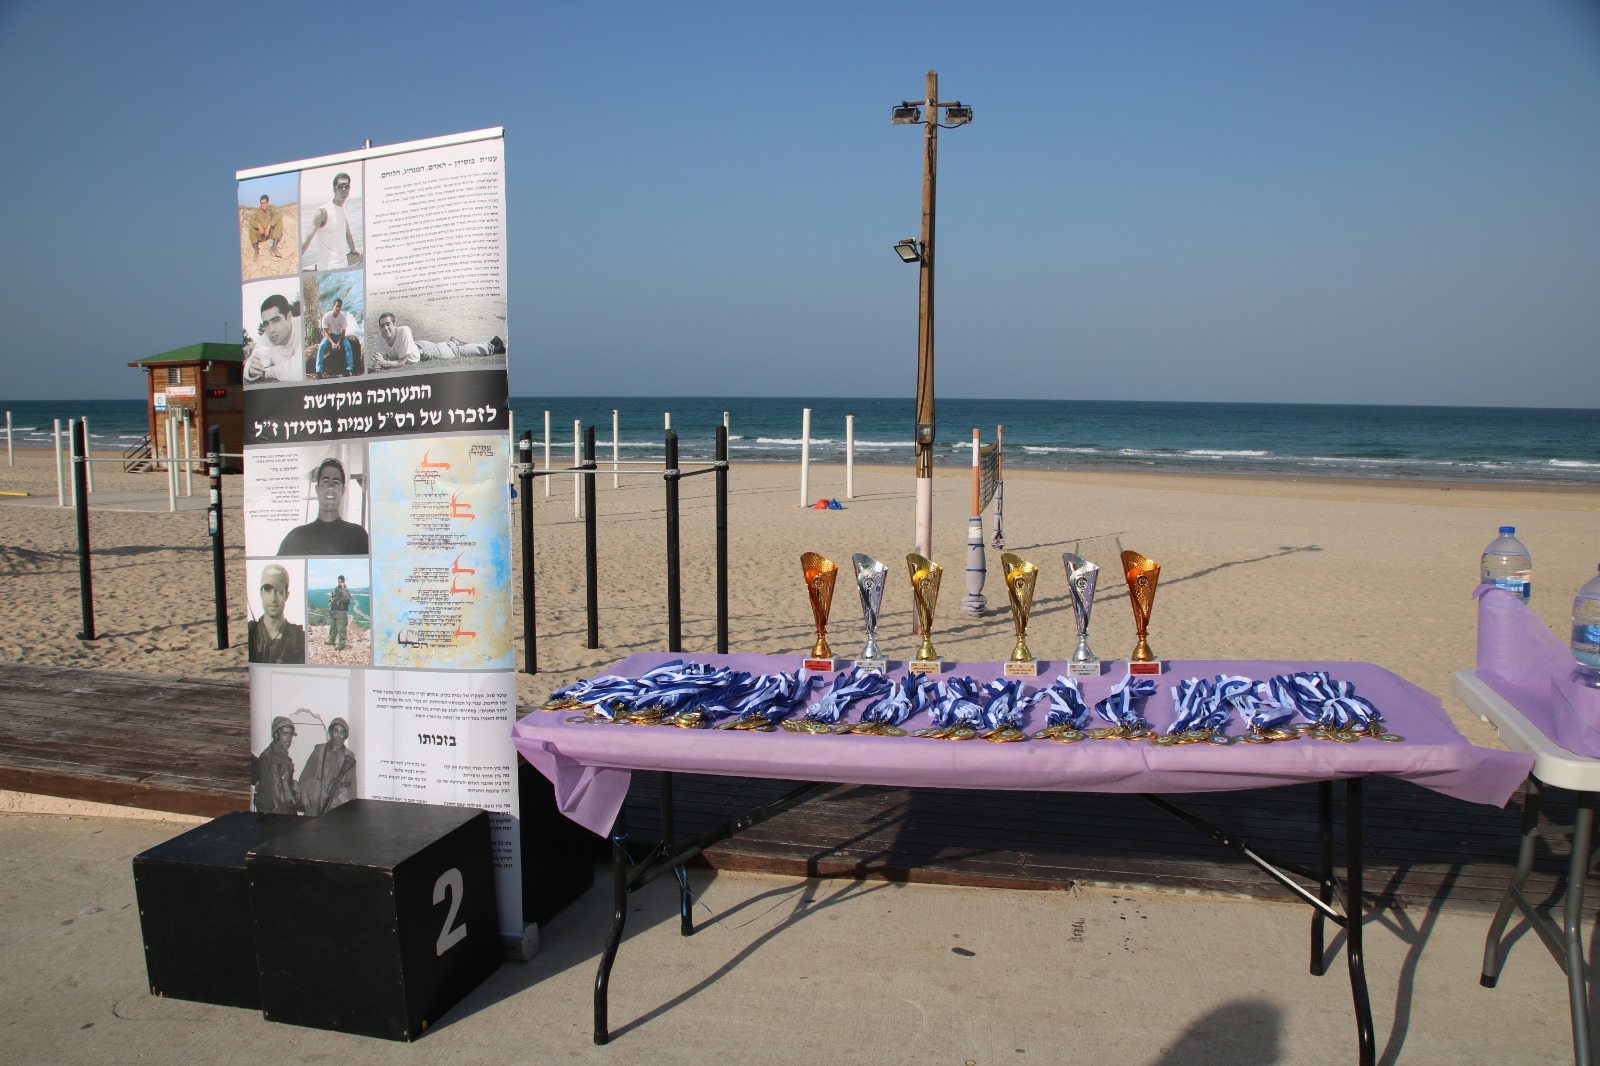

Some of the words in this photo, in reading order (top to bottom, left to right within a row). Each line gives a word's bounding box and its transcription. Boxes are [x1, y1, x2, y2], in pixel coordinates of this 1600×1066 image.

[454, 158, 475, 168] בוסידן
[480, 156, 497, 164] עמית
[303, 390, 363, 410] מוקדשת
[367, 384, 432, 404] התערוכה
[420, 407, 443, 426] של
[447, 404, 497, 423] לזכרו
[283, 419, 333, 440] בוסידן
[337, 416, 373, 432] עמית
[417, 733, 457, 747] בזכותו
[433, 868, 467, 956] 2
